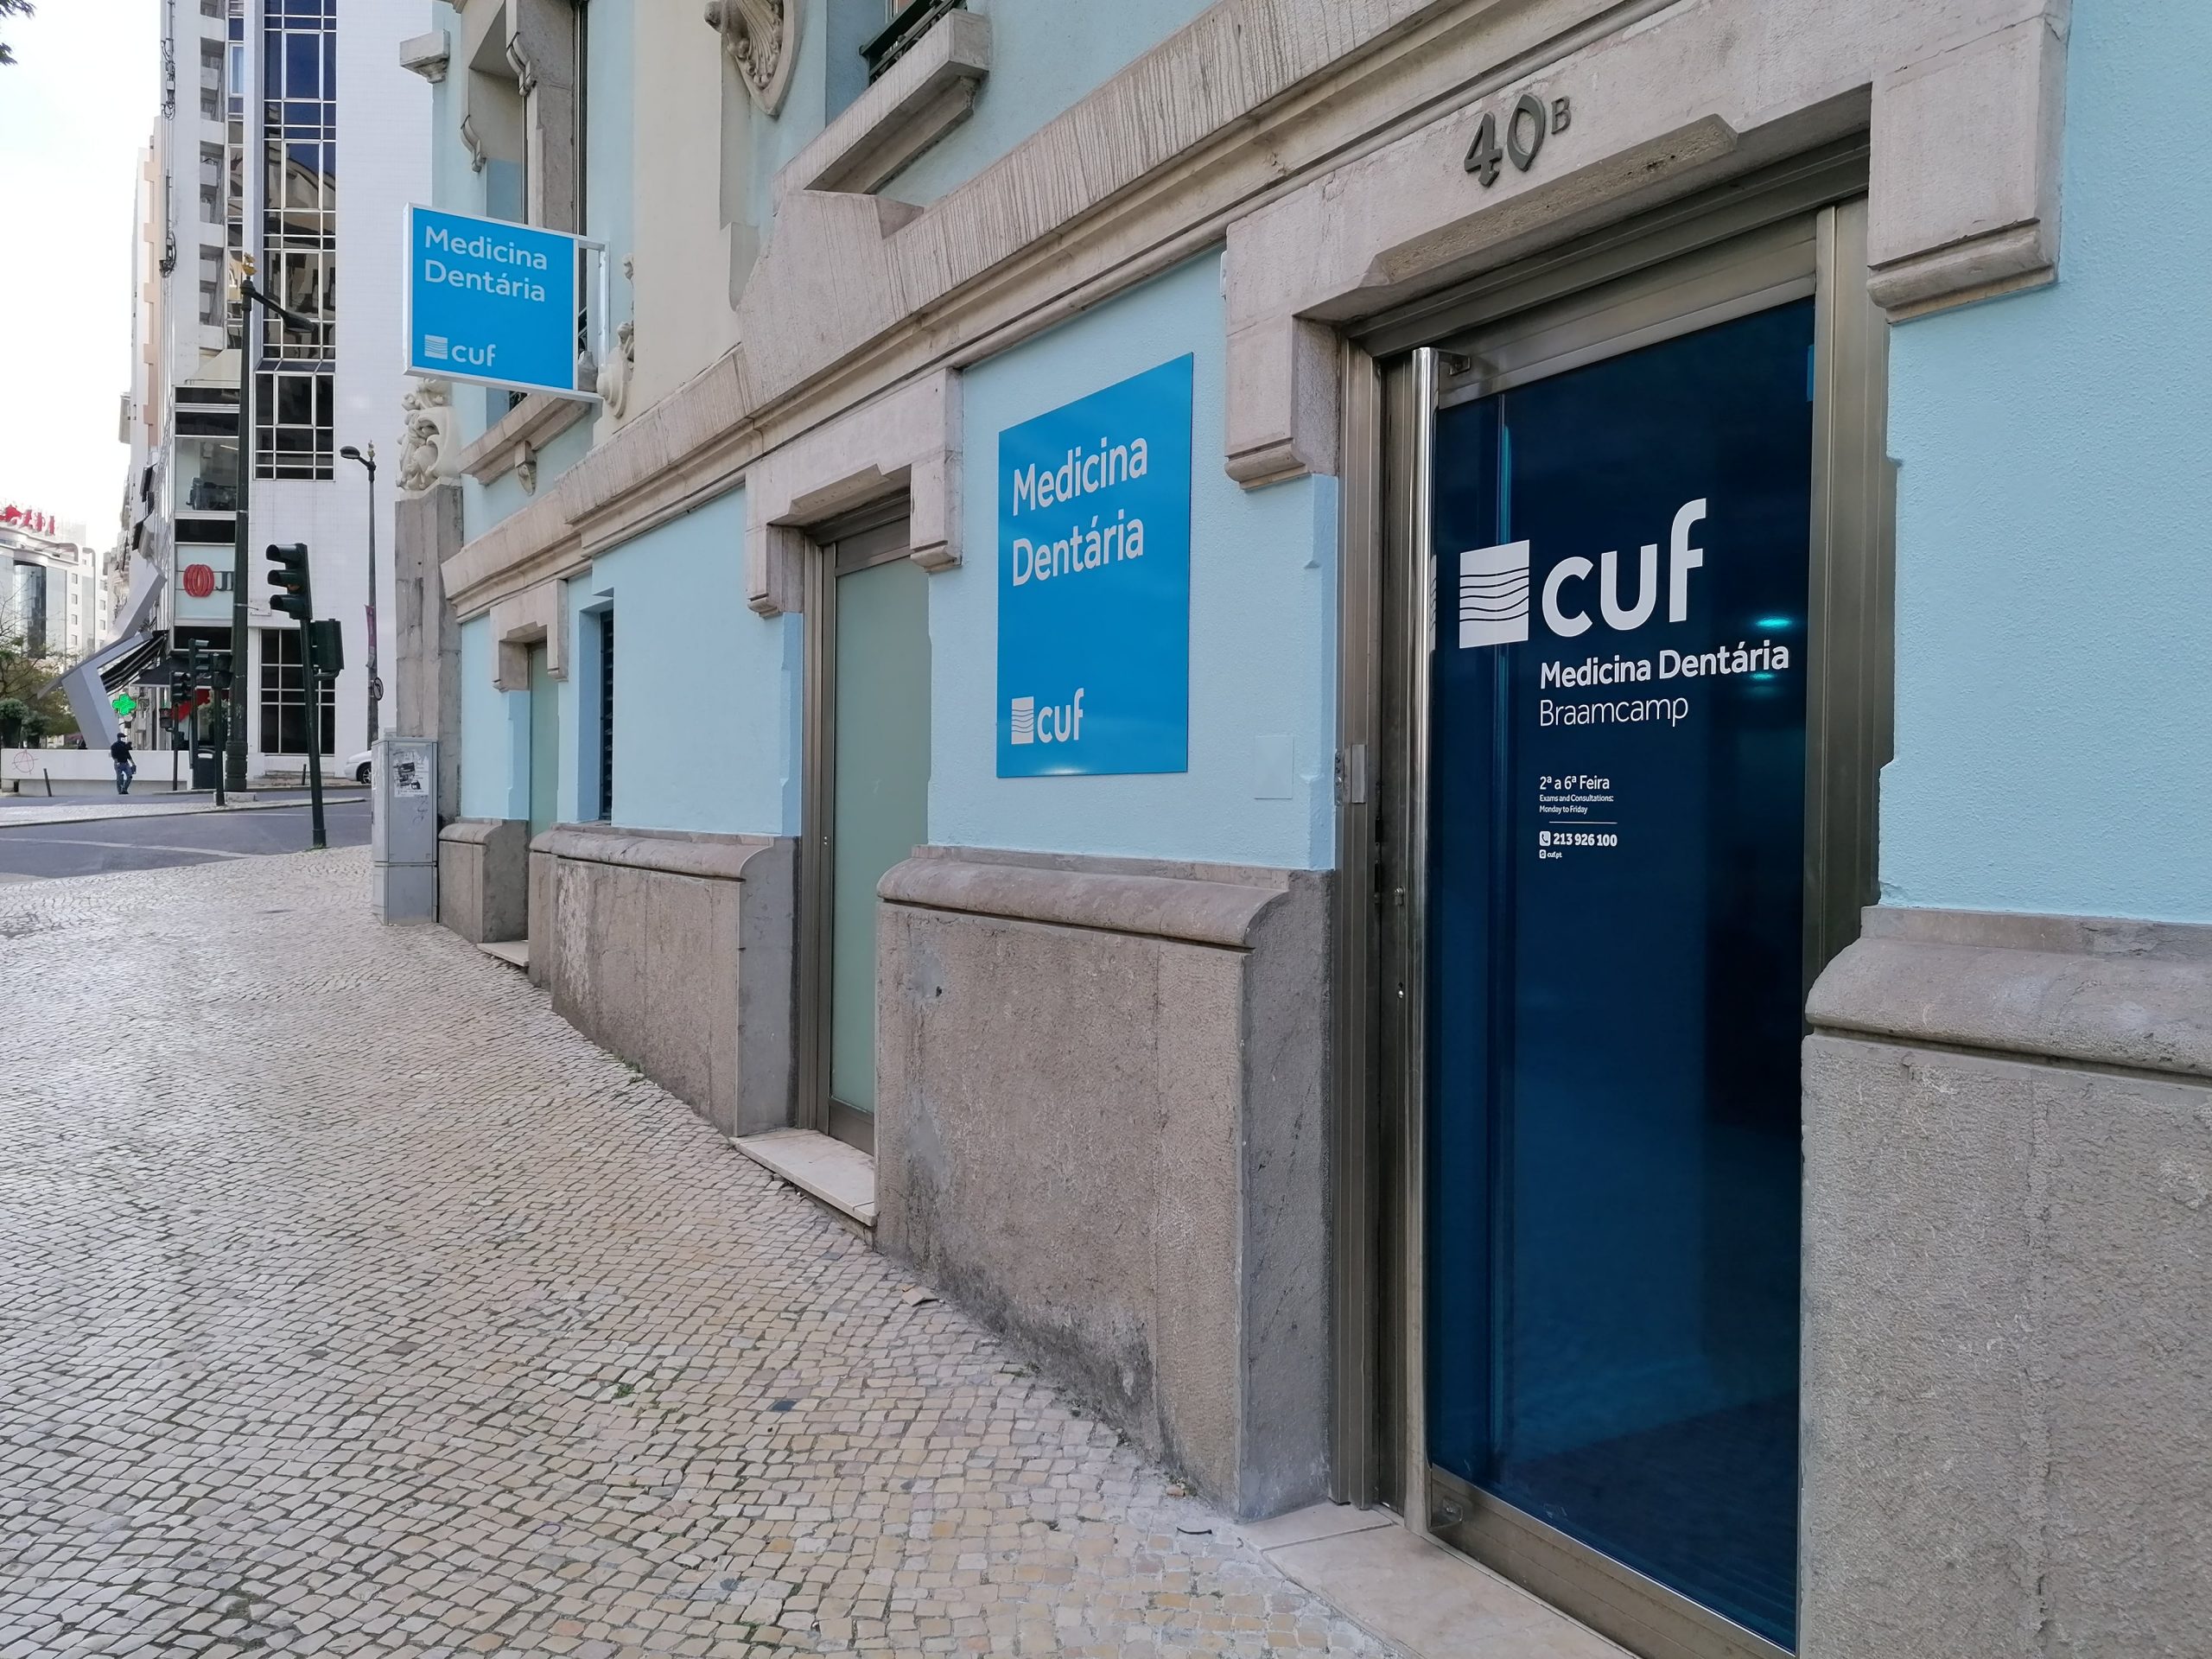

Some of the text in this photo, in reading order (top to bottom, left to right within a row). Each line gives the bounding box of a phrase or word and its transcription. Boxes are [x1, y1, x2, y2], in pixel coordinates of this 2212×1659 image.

[425, 226, 547, 270] Medicina
[425, 259, 545, 302] Dentária
[451, 344, 496, 367] cuf
[1013, 436, 1148, 516] Medicina
[1013, 509, 1144, 587] Dentária
[1541, 498, 1707, 638] cuf
[1541, 639, 1789, 690] Medicina Dentária
[1037, 688, 1084, 743] cuf
[1540, 696, 1688, 728] Braamcamp
[1554, 779, 1561, 790] a
[1580, 775, 1610, 790] Feira
[1539, 805, 1562, 814] Monday
[1570, 805, 1587, 815] Friday
[1553, 833, 1618, 846] 213 926 100
